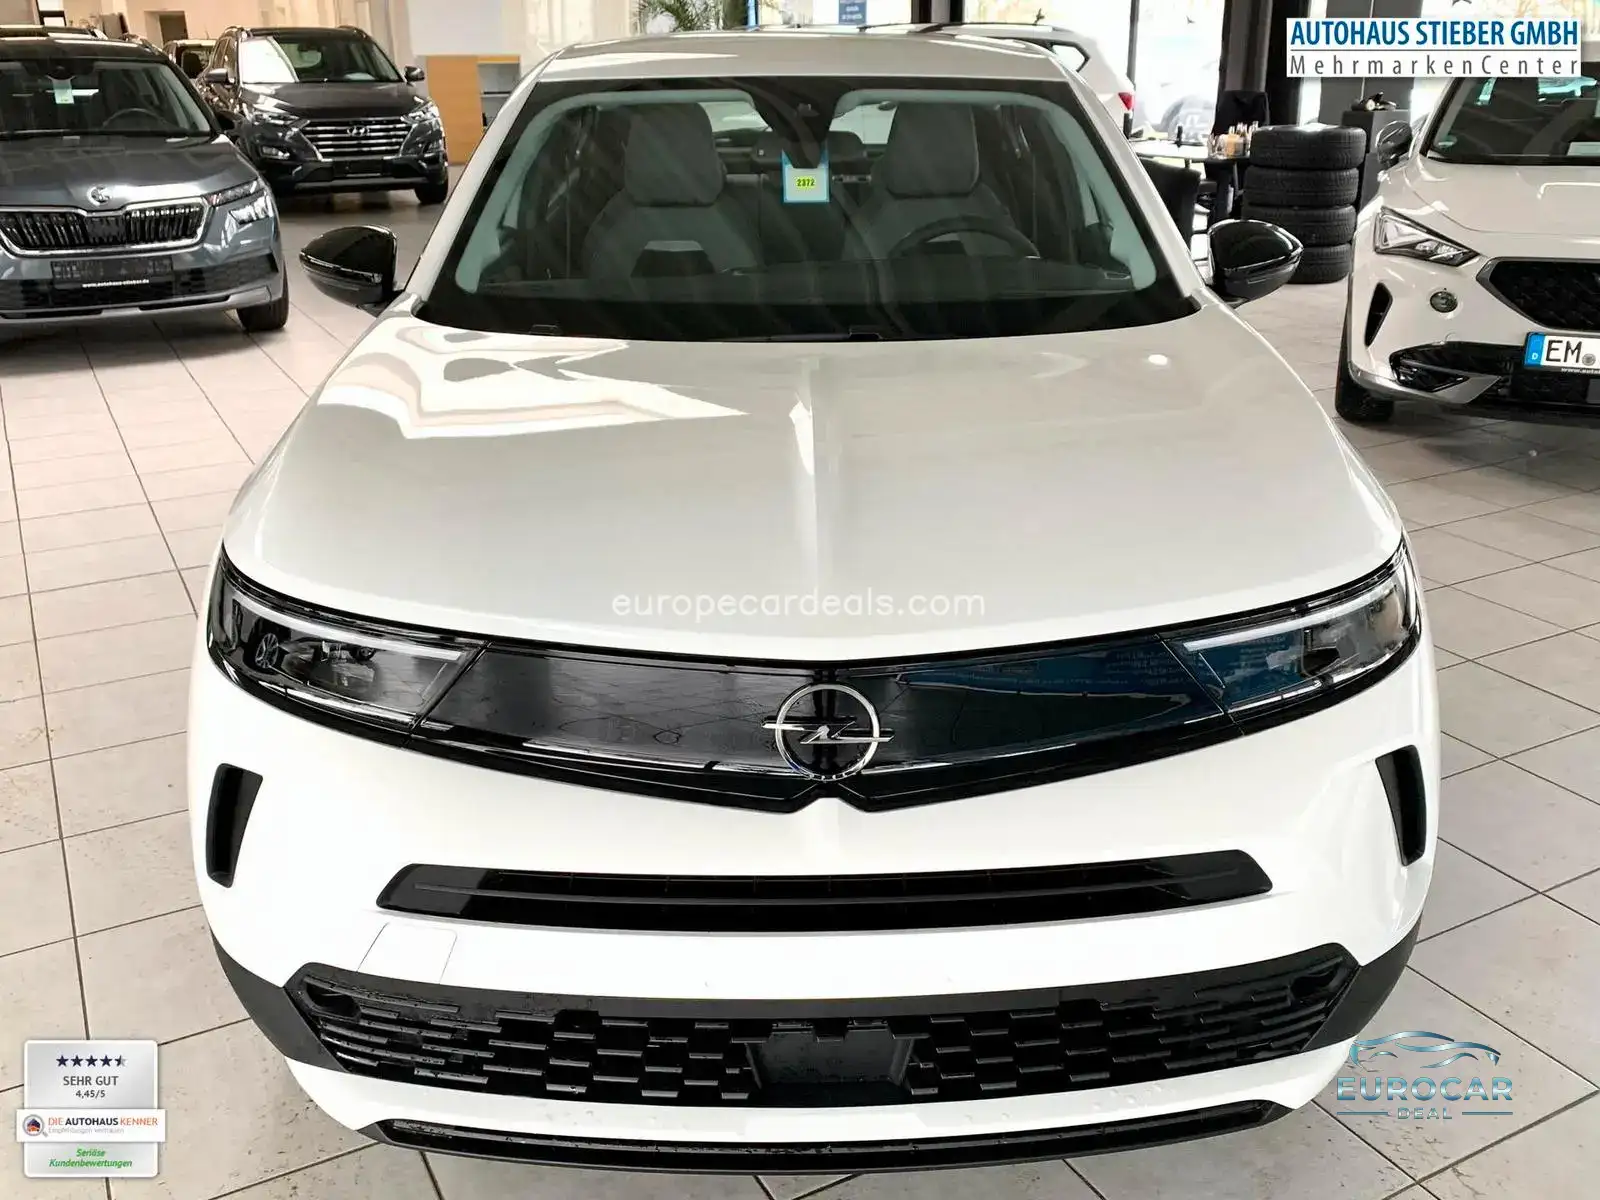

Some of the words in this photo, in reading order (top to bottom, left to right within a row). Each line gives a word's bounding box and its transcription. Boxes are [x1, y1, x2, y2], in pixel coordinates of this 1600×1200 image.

[796, 178, 816, 187] 2372
[1531, 352, 1539, 360] D
[1545, 339, 1583, 363] EM
